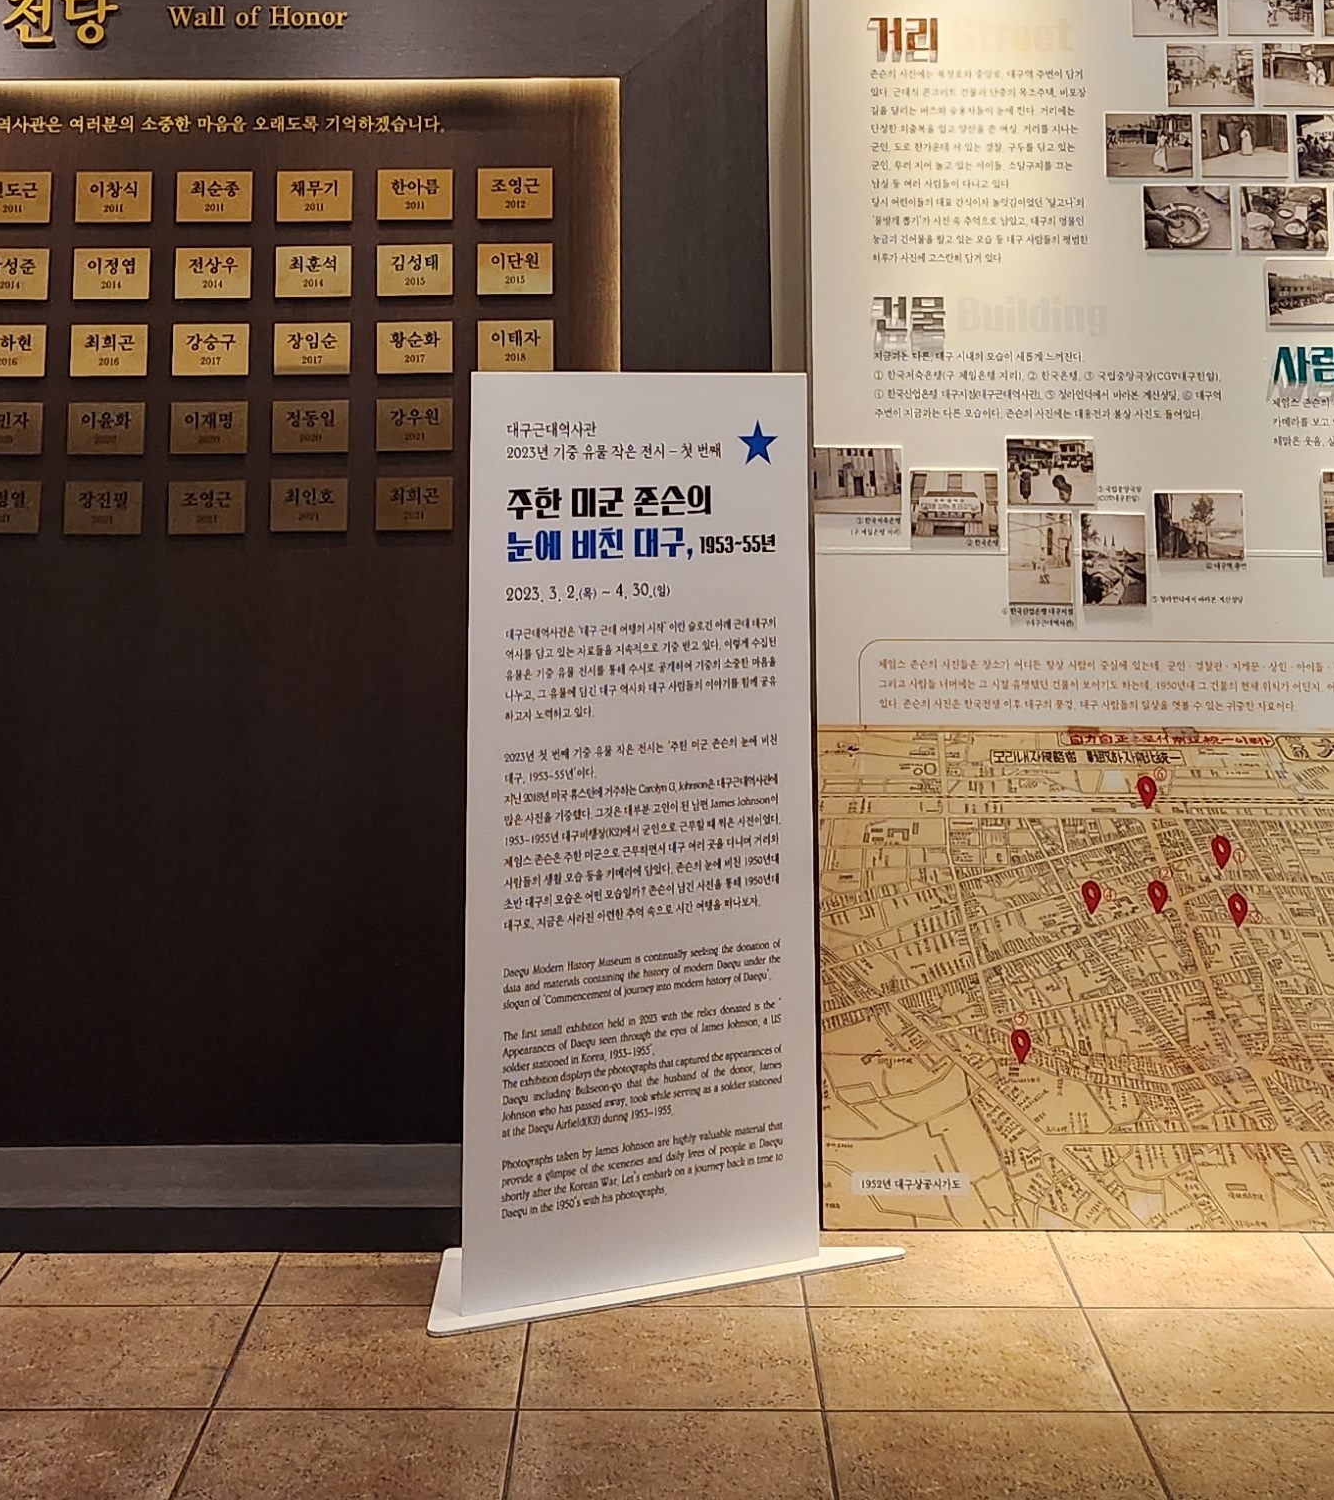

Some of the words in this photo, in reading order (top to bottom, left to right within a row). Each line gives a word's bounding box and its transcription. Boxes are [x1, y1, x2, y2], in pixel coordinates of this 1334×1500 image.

[169, 4, 226, 28] Wall
[236, 4, 261, 28] of
[269, 4, 348, 29] Honor
[867, 18, 938, 53] 거리
[69, 116, 134, 134] 여러분의
[141, 115, 191, 133] 소중한
[197, 115, 246, 133] 마음을
[253, 115, 317, 133] 오래도록
[325, 115, 446, 134] 기억하겠습니다.
[90, 180, 139, 198] 이창식
[191, 180, 240, 198] 최순종
[291, 179, 339, 198] 채무기
[491, 176, 540, 194] 조영근
[87, 256, 136, 275] 이정엽
[189, 256, 238, 274] 전상우
[290, 254, 337, 273] 최훈석
[391, 254, 439, 272] 김성태
[491, 252, 540, 270] 이단원
[873, 296, 946, 332] 건물
[957, 295, 1107, 336] Building
[85, 334, 135, 352] 최희곤
[187, 333, 236, 352] 강승구
[287, 332, 337, 350] 장임순
[390, 330, 441, 349] 황순화
[491, 330, 540, 348] 이태자
[200, 356, 221, 366] 2017
[301, 354, 323, 364] 2017
[404, 354, 425, 364] 2017
[505, 352, 527, 362] 2018
[81, 411, 132, 430] 이윤화
[184, 410, 233, 430] 이재명
[390, 407, 441, 426] 강우원
[507, 421, 596, 438] 대구근대역사관
[506, 444, 549, 461] 2023년
[554, 444, 578, 461] 기증
[583, 445, 607, 460] 유물
[611, 443, 637, 460] 작은
[641, 443, 665, 460] 전시
[681, 443, 693, 459] 첫
[698, 442, 722, 459] 번째
[182, 489, 233, 508] 조영근
[285, 487, 335, 506] 최인호
[507, 487, 562, 520] 주한
[572, 487, 624, 518] 미군
[634, 485, 712, 517] 존슨의
[507, 529, 561, 562] 눈에
[572, 527, 624, 560] 비친
[634, 527, 693, 560] 대구,
[699, 534, 776, 554] 1953~55년
[505, 586, 544, 603] 2023.
[549, 585, 562, 602] 3.
[616, 583, 627, 600] 4.
[861, 1178, 891, 1190] 1952년
